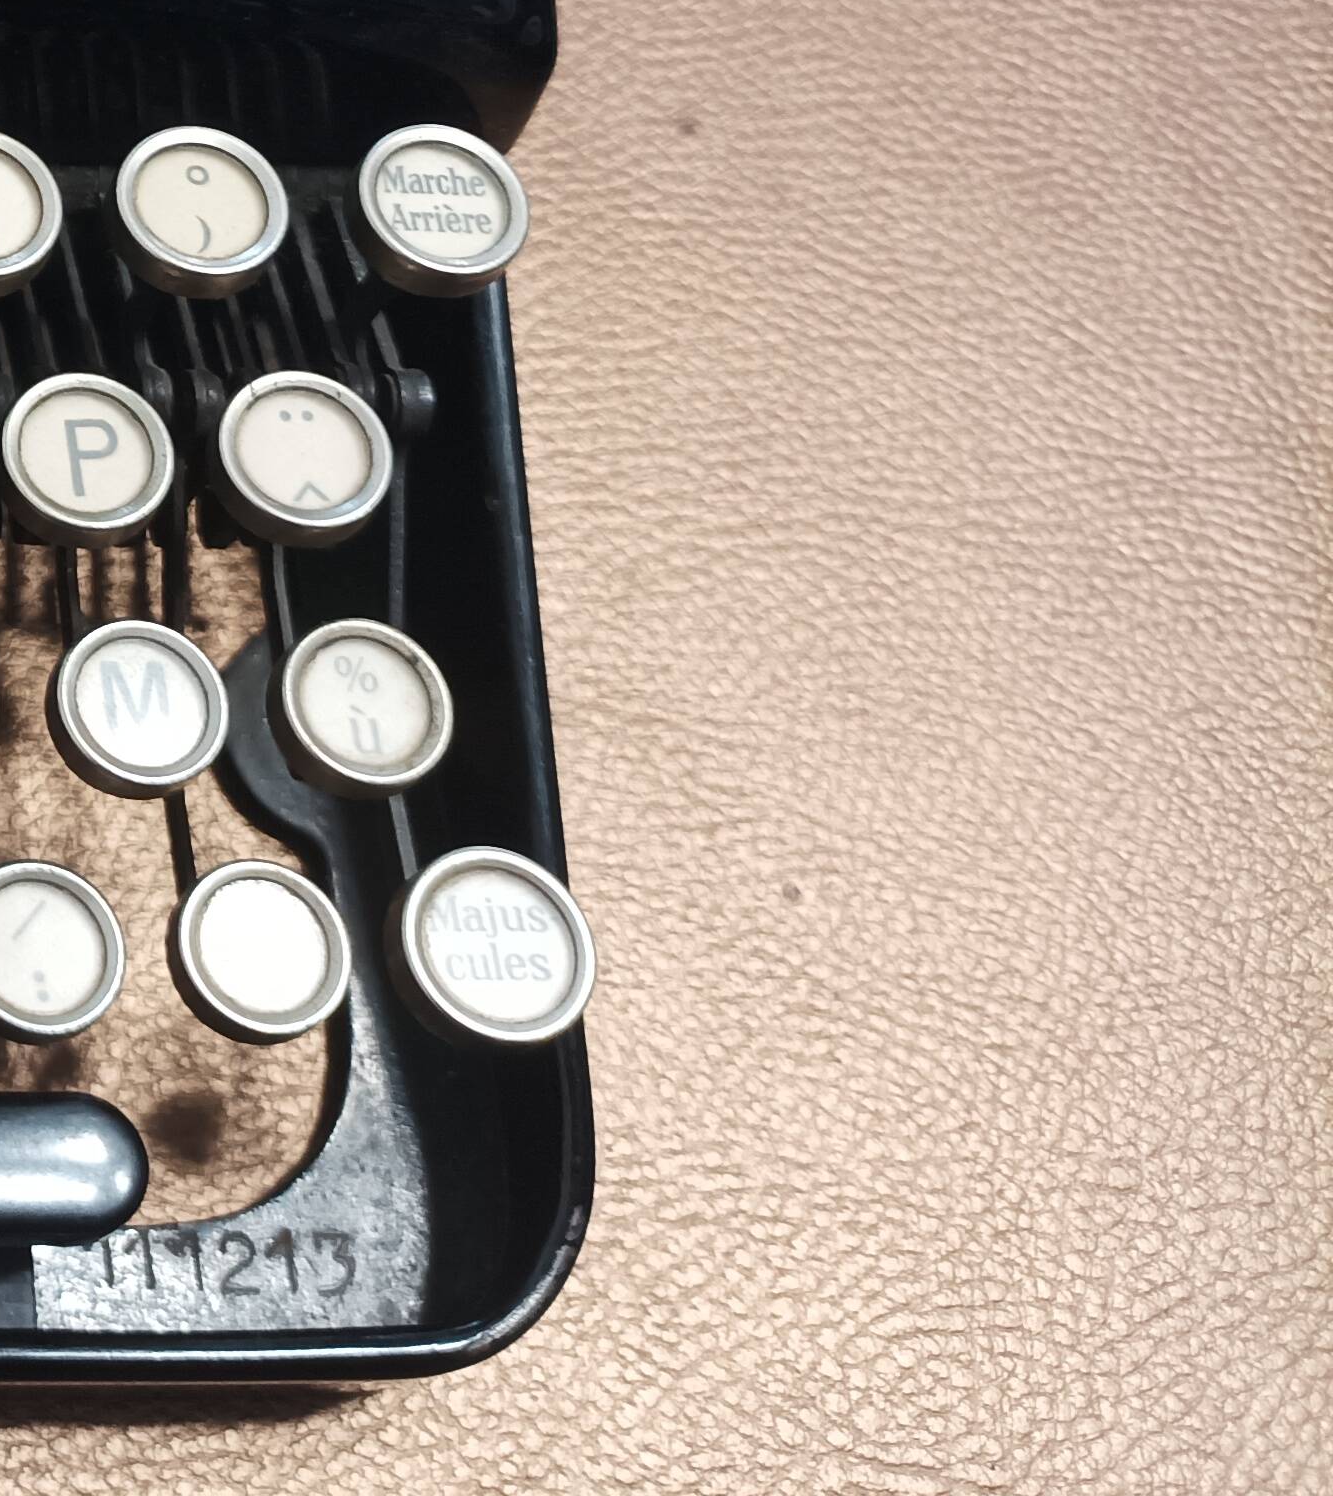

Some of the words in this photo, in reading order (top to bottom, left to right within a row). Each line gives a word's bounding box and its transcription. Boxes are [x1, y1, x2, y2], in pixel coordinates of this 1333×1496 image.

[384, 165, 485, 196] Marche
[197, 217, 211, 253] )
[391, 203, 493, 234] Arrière
[64, 419, 118, 497] P
[333, 656, 378, 692] %
[101, 660, 170, 730] M
[445, 943, 553, 981] cules
